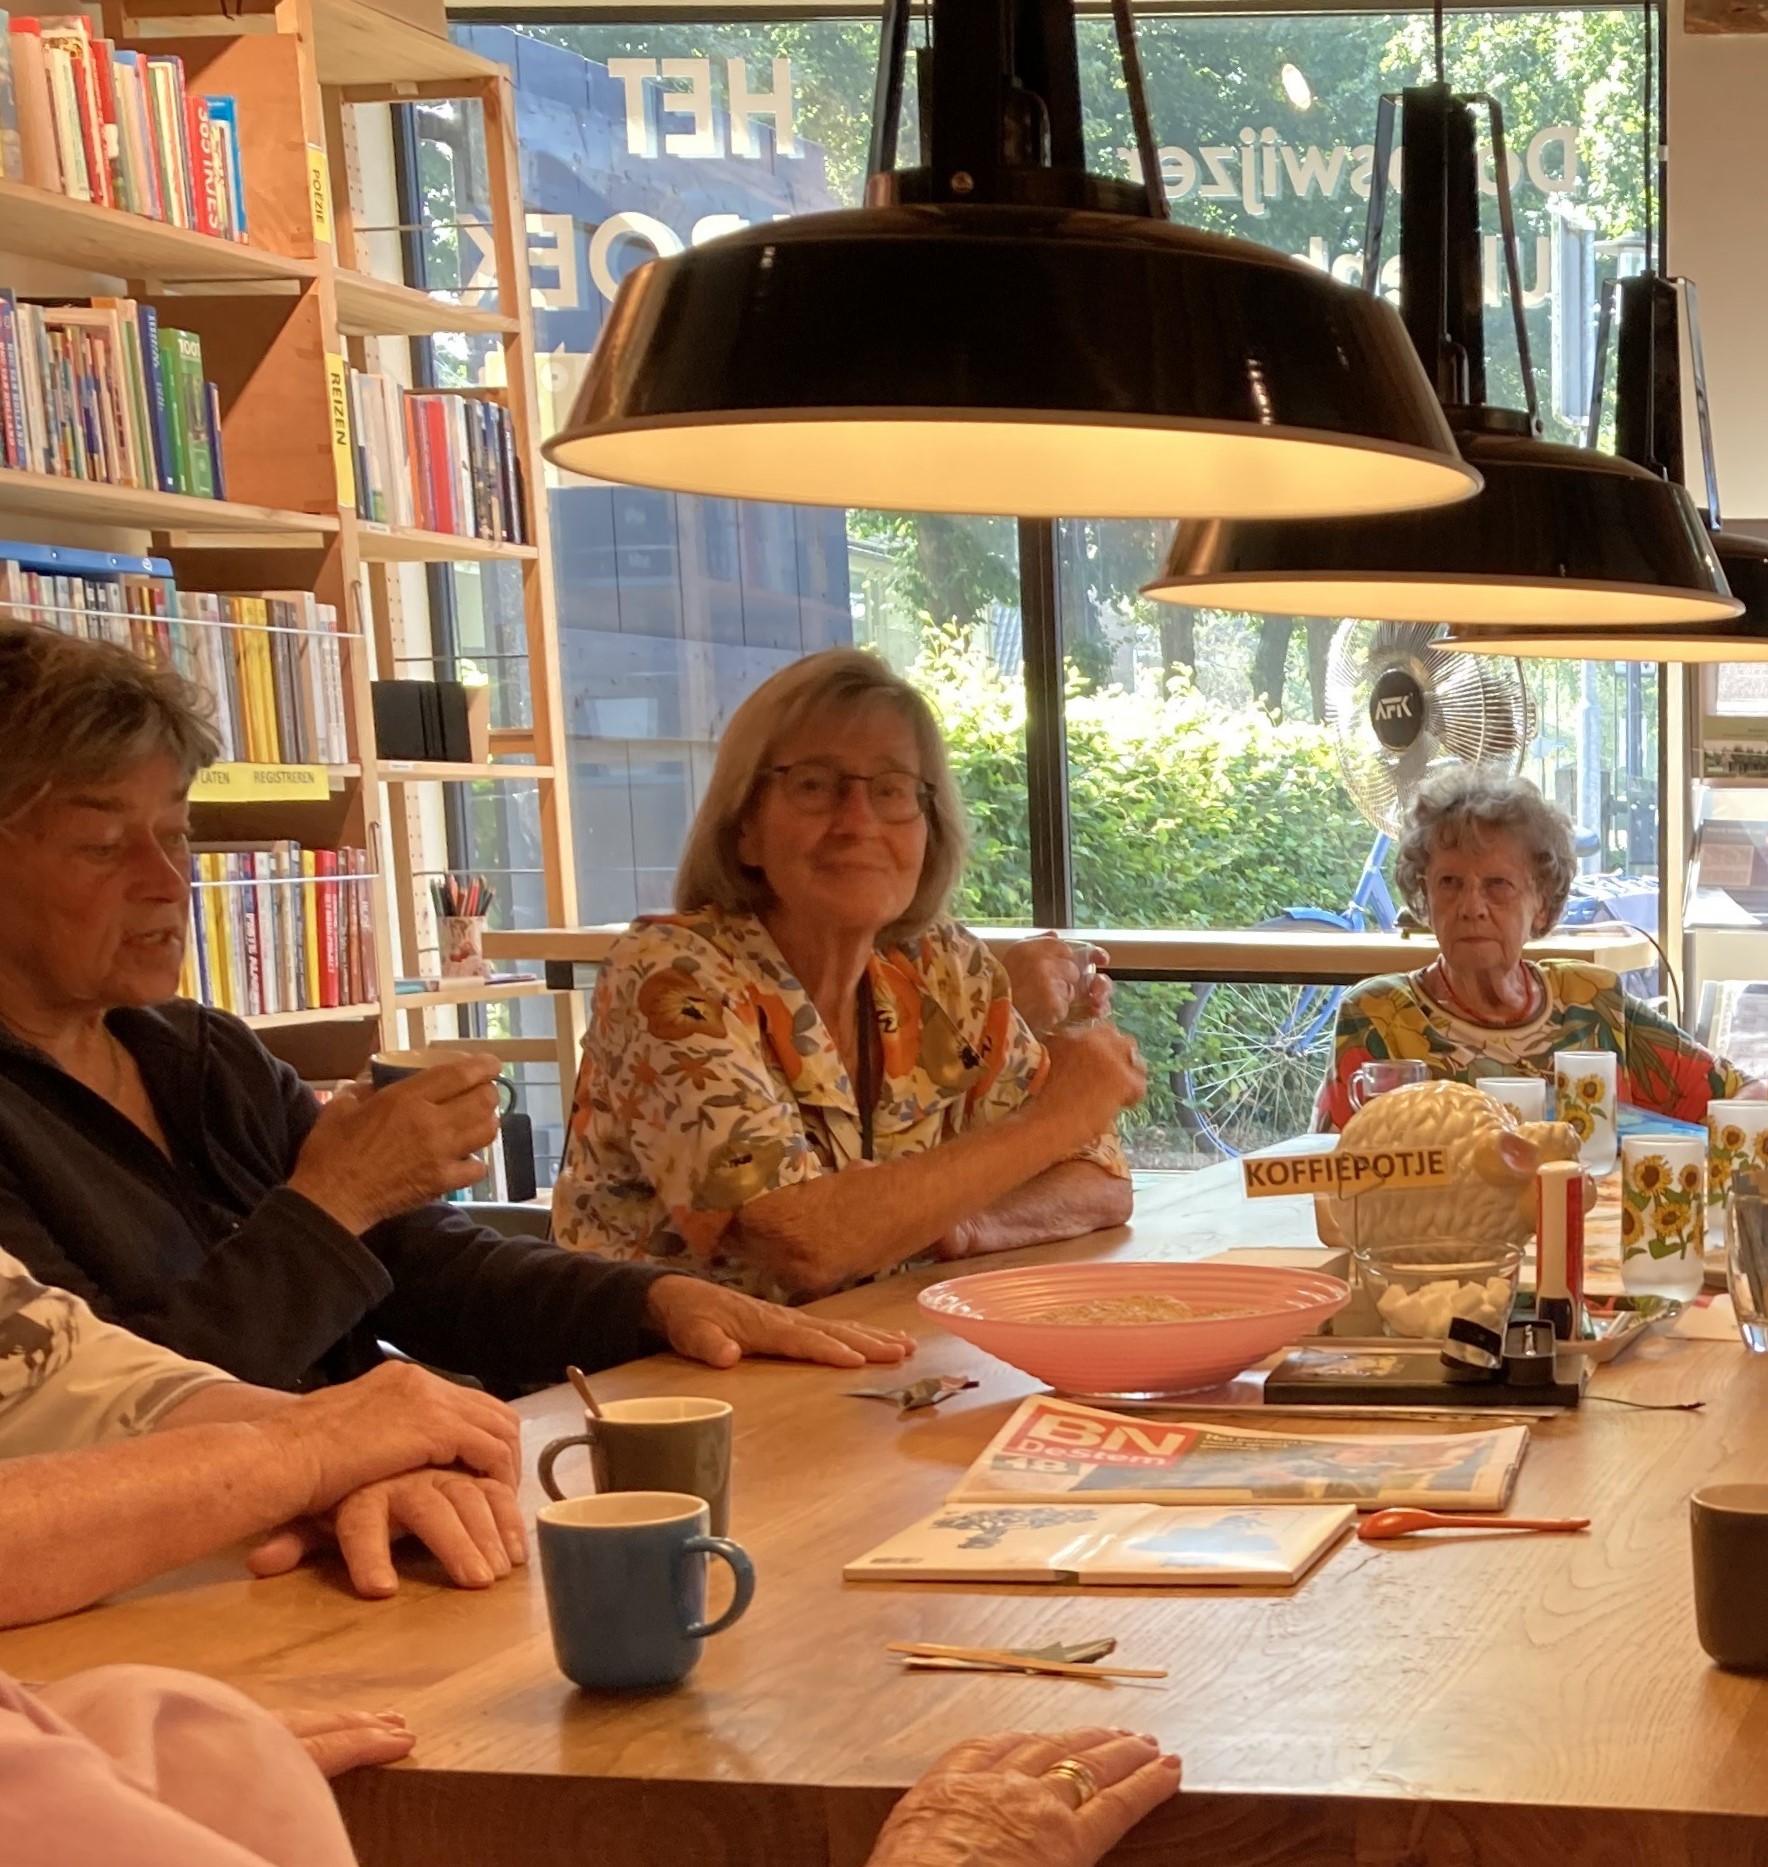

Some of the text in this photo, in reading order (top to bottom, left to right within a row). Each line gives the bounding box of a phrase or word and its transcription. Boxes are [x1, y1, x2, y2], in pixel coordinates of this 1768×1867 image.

[331, 372, 347, 446] REIZEN
[253, 770, 315, 784] REGISTREREN
[1245, 1150, 1445, 1188] KOFFIEPOTJE
[1014, 1438, 1166, 1466] DeStem
[1027, 1413, 1187, 1456] BN
